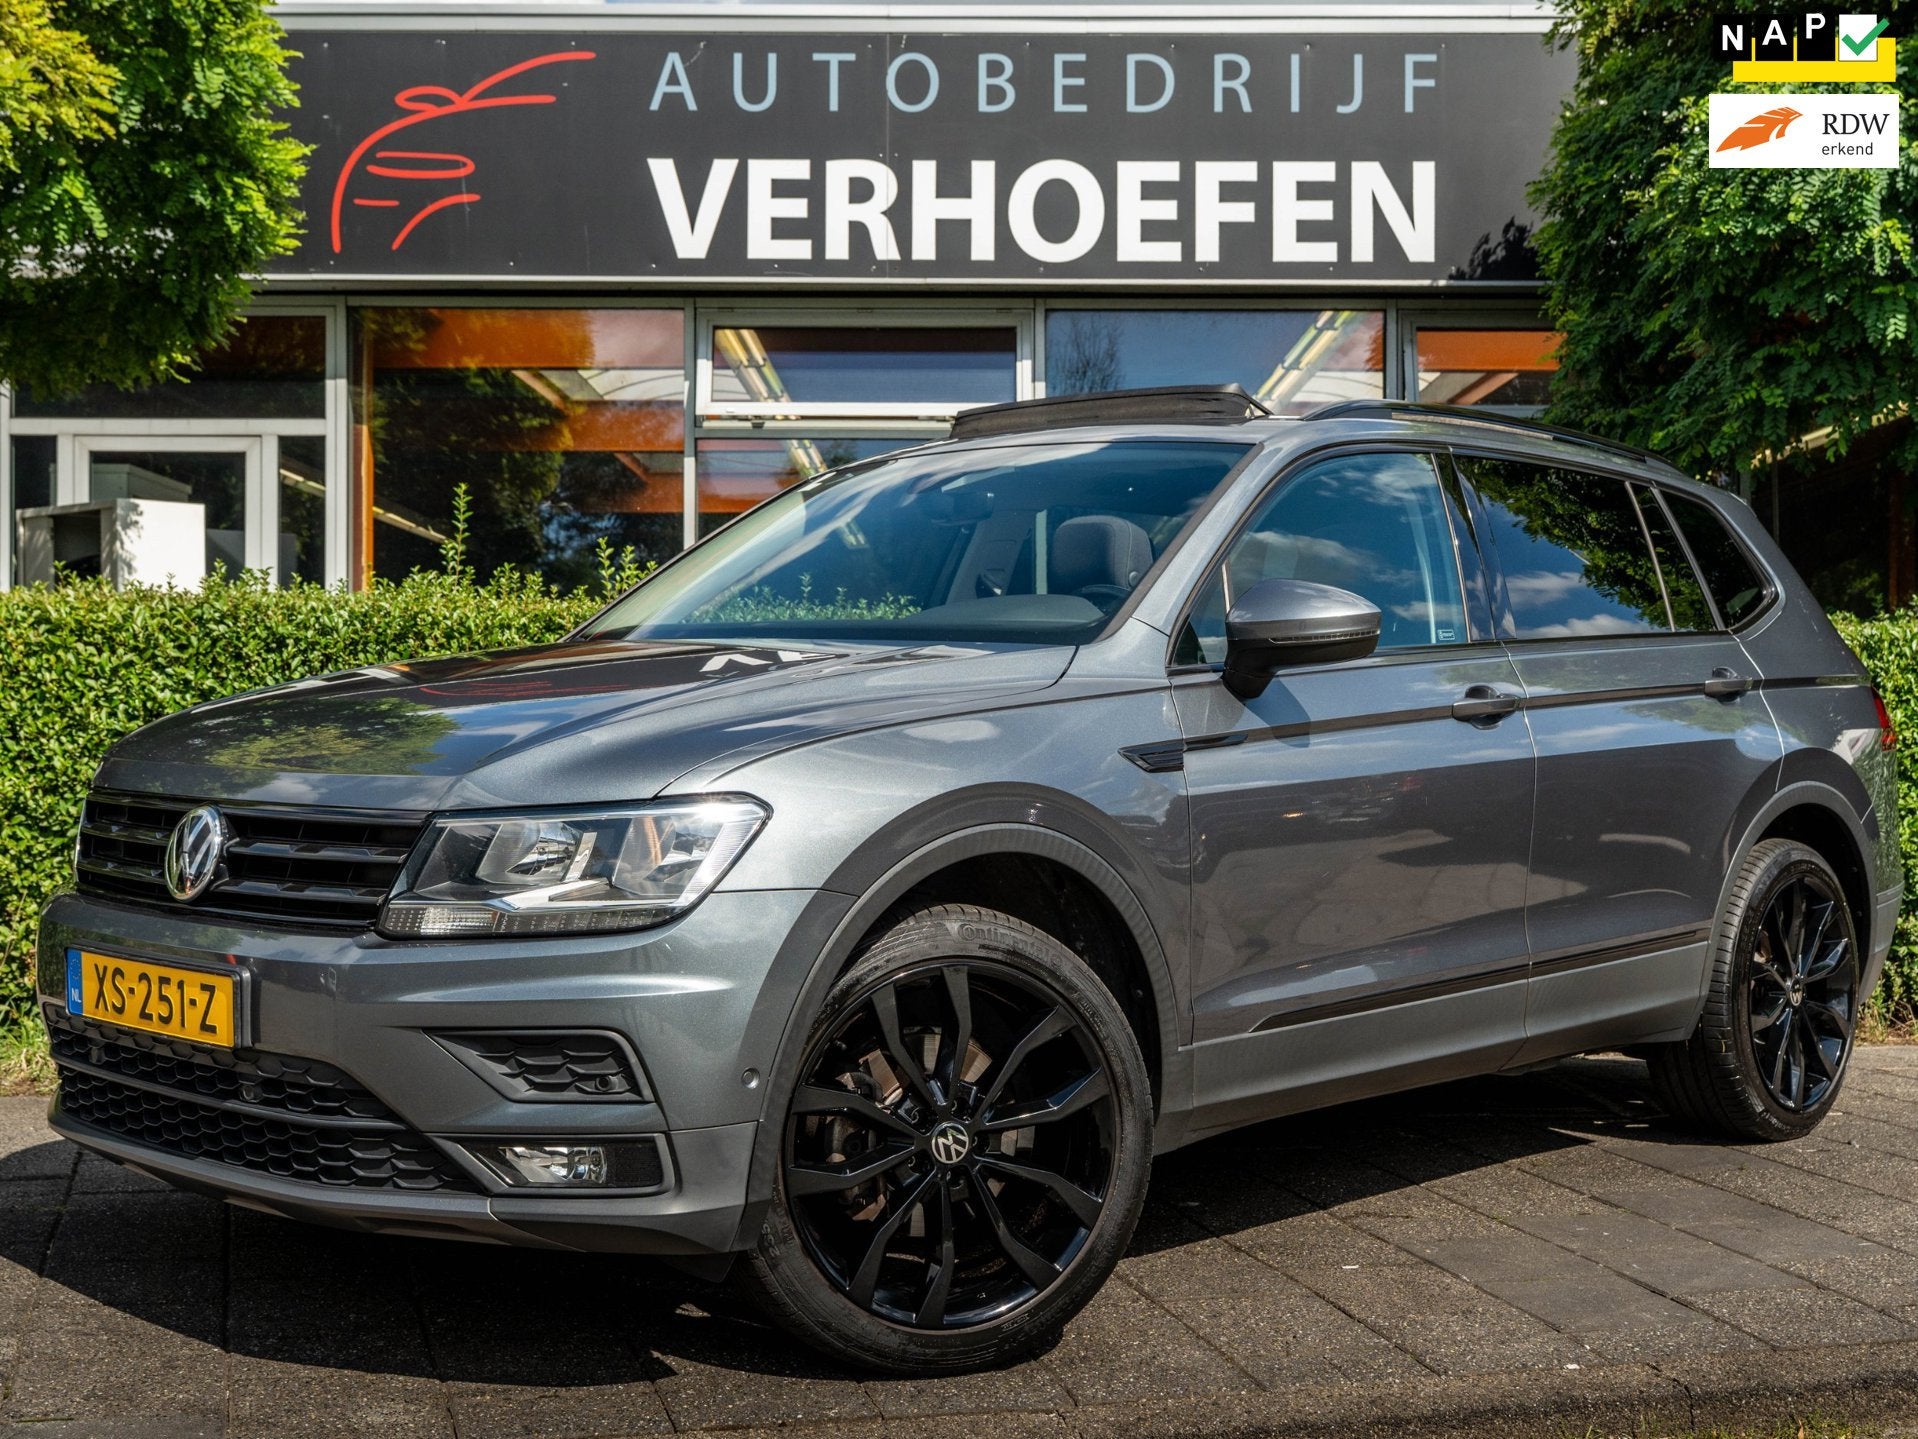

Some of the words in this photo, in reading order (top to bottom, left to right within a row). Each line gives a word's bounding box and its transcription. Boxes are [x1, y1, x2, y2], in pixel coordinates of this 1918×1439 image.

[649, 51, 1438, 115] AUTOBEDRIJF
[647, 158, 1436, 263] VERHOEFEN
[71, 987, 82, 1003] NL
[94, 963, 218, 1035] XS-251-Z
